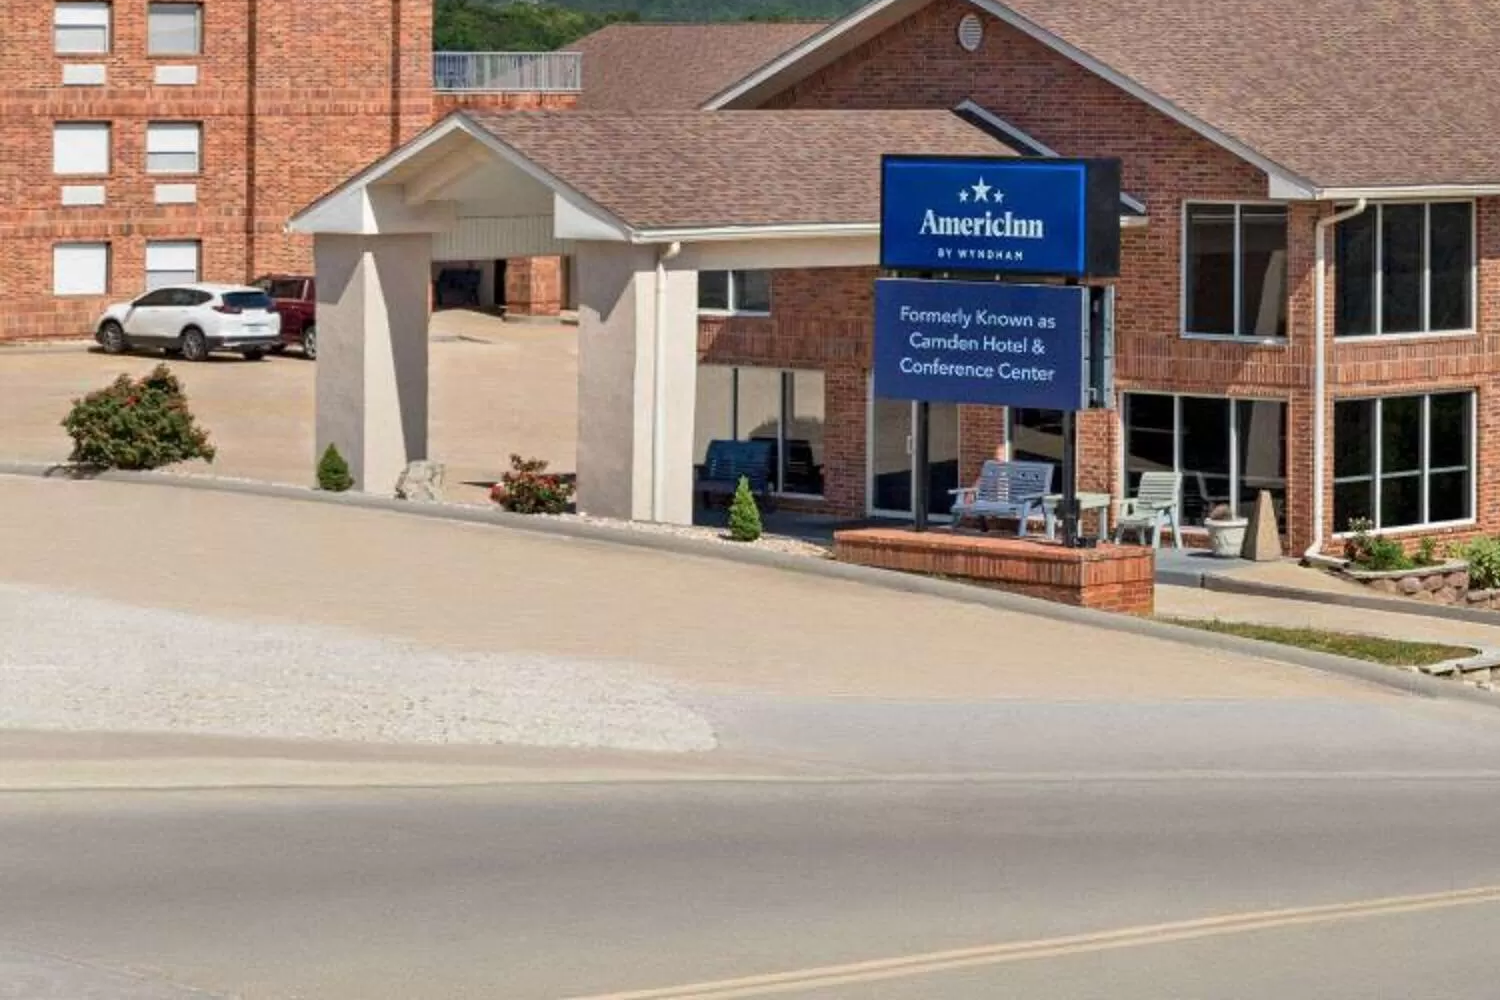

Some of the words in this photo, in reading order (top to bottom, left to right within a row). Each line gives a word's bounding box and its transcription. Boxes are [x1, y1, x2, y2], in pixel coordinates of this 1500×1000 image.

[918, 209, 1044, 239] AmericInn
[937, 247, 952, 258] BY
[957, 248, 1024, 261] WYNDHAM
[900, 305, 972, 329] Formerly
[976, 310, 1034, 328] Known
[1037, 315, 1056, 329] as
[909, 332, 979, 351] Camden
[983, 335, 1028, 354] Hotel
[1031, 338, 1046, 355] &
[899, 356, 995, 378] Conference
[999, 363, 1057, 382] Center
